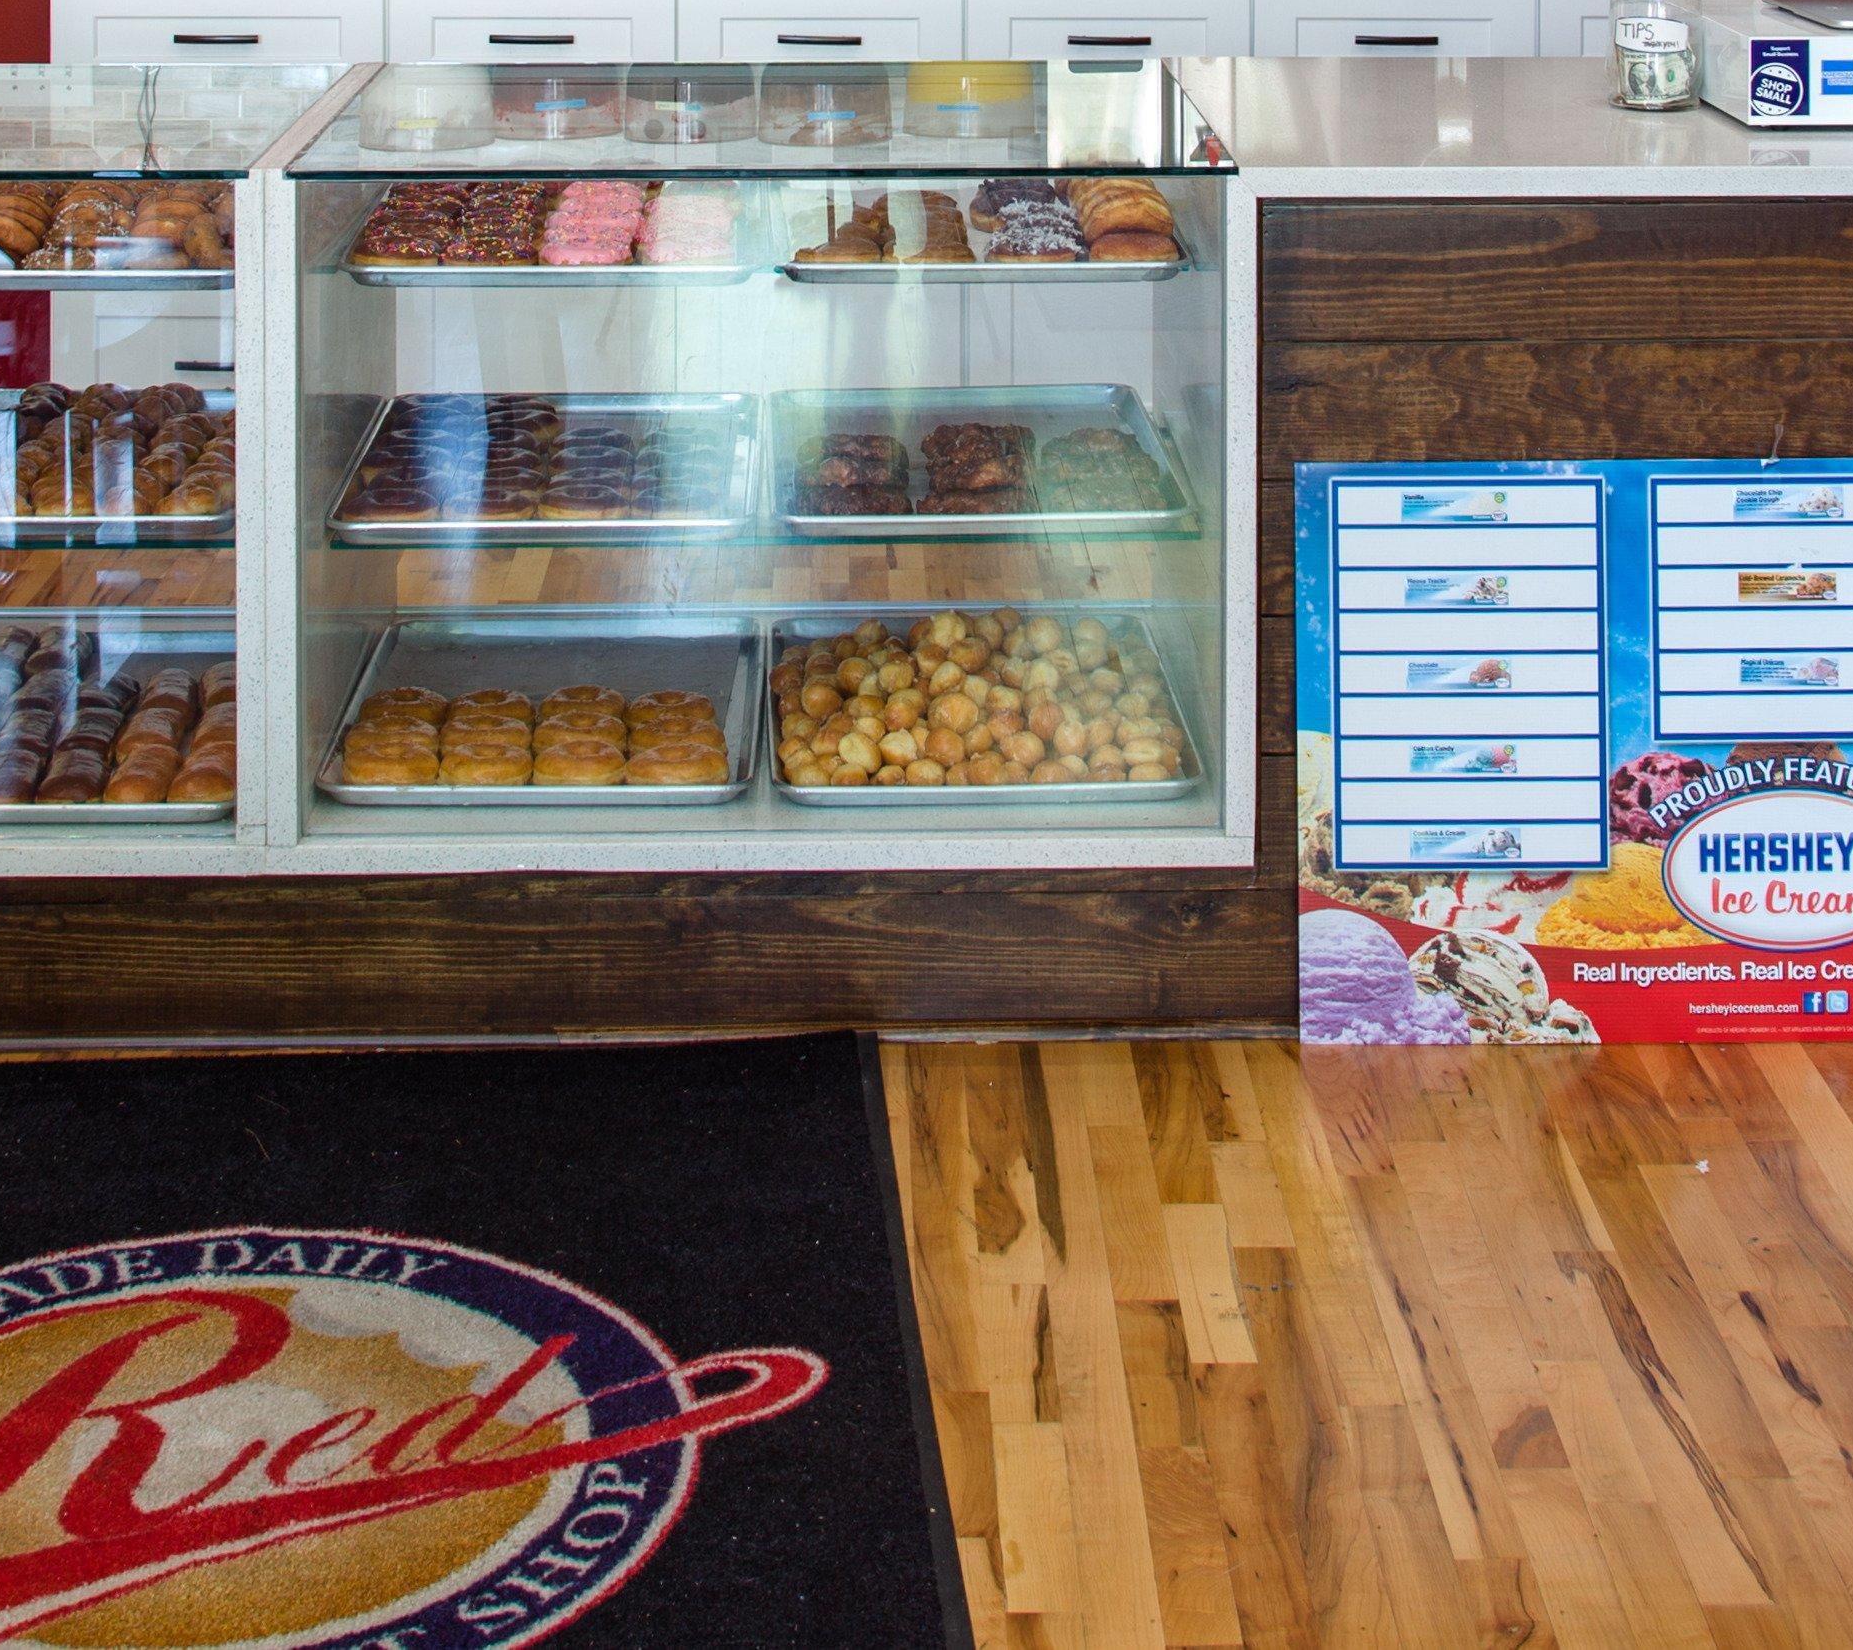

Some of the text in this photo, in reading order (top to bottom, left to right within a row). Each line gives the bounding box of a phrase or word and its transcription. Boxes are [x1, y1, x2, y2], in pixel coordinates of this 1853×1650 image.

[1620, 22, 1655, 40] TIPS
[1760, 78, 1793, 94] SHOP
[1755, 87, 1792, 105] SMALL
[1736, 489, 1783, 498] Chocolate Chip
[1759, 496, 1780, 505] Dough
[1740, 658, 1762, 667] Magical
[1649, 757, 1776, 829] PROUDLY
[1711, 877, 1756, 914] Ice
[1573, 962, 1617, 982] Real
[1621, 961, 1736, 987] Ingredients.
[1740, 960, 1783, 981] Real
[1787, 960, 1817, 981] Ice
[1688, 1000, 1799, 1017] hersheyicecream.com
[197, 1239, 450, 1286] DAILY
[456, 1461, 650, 1636] SHOP
